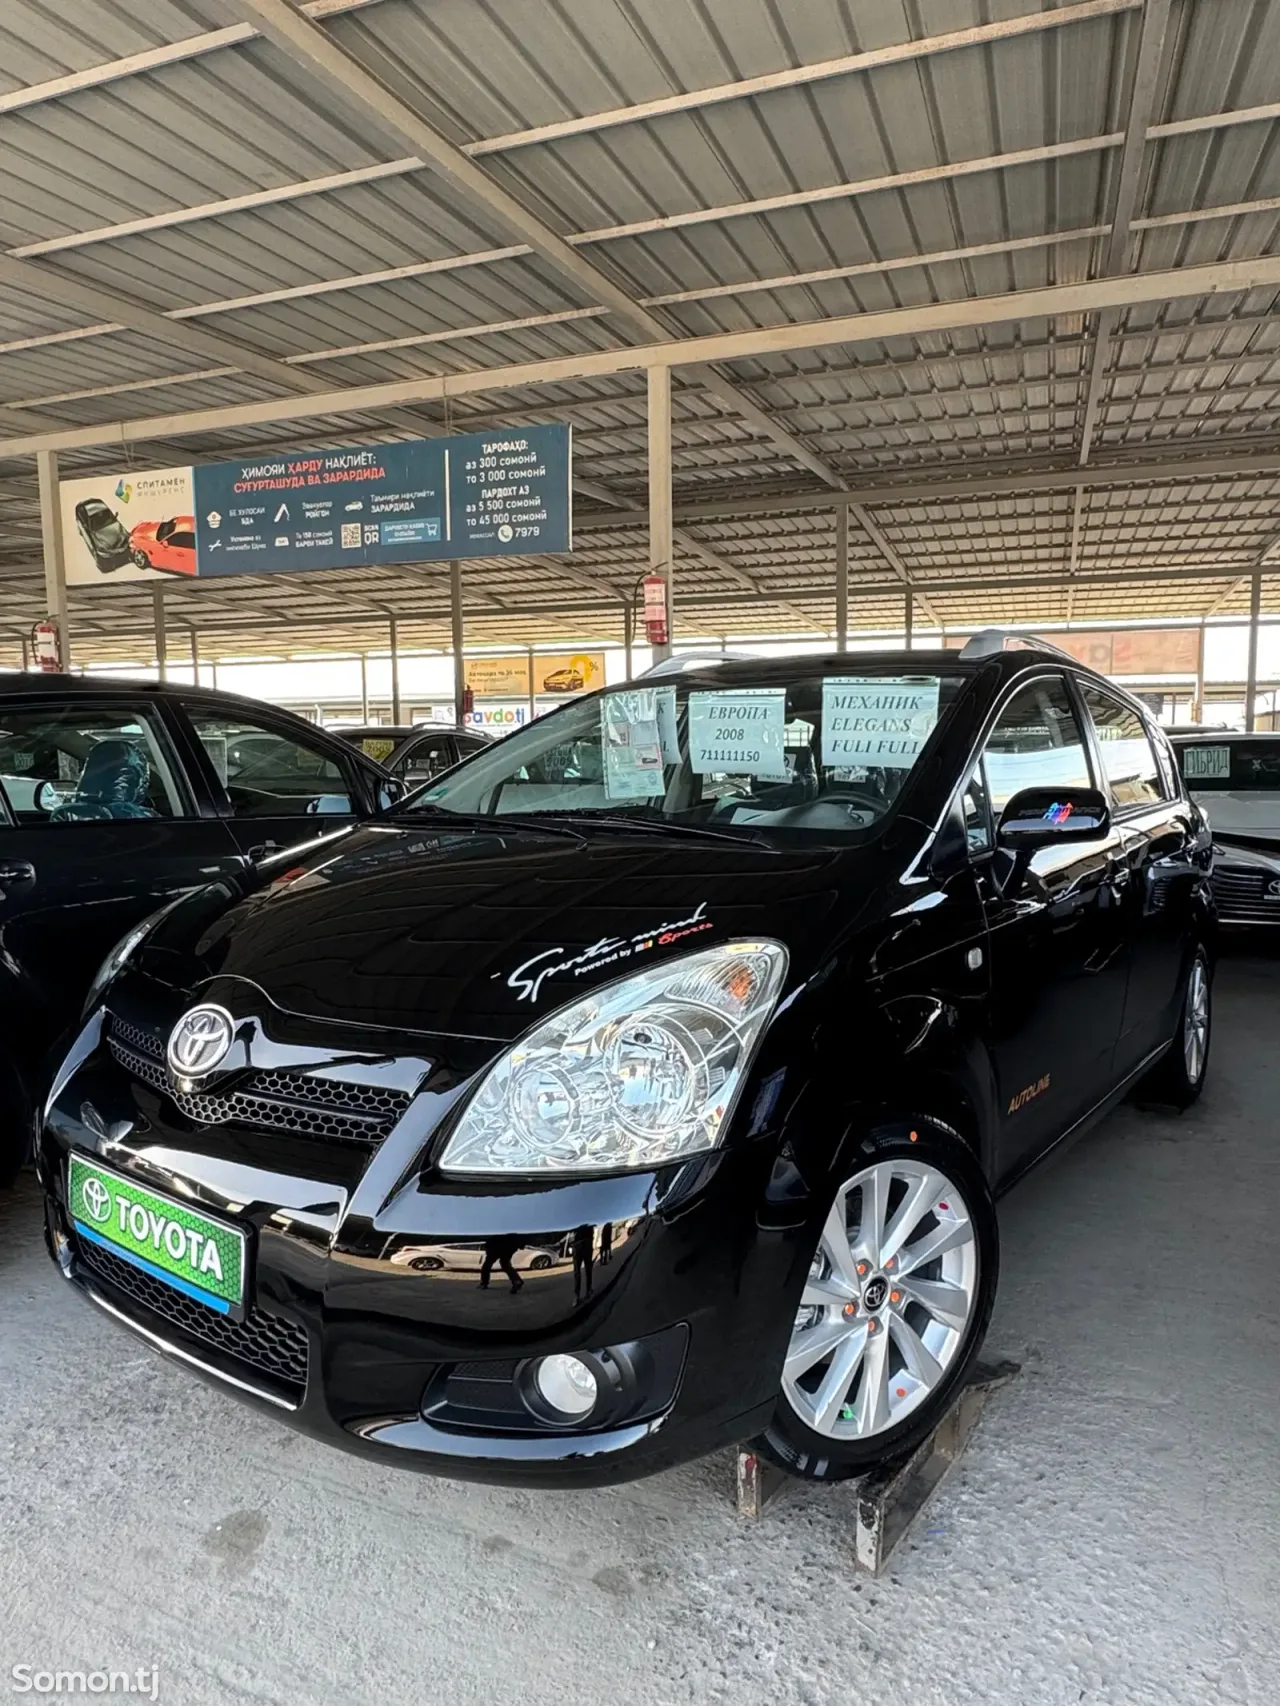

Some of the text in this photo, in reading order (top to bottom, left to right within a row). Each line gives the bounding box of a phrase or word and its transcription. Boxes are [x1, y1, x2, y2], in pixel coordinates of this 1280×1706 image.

[465, 461, 476, 470] аз
[479, 457, 497, 468] 300
[307, 475, 321, 486] ВА
[323, 467, 386, 484] ЗАРАРДИДА
[466, 475, 477, 484] то
[479, 472, 486, 482] 3
[488, 470, 506, 481] 000
[481, 487, 517, 499] ПАРДОХТ
[371, 502, 415, 513] ЗАРАРДИДА
[466, 504, 477, 513] аз
[478, 501, 485, 511] 5
[487, 499, 504, 510] 500
[466, 518, 477, 527] то
[479, 515, 490, 525] 45
[492, 513, 510, 524] 000
[364, 532, 380, 544] QR
[515, 526, 540, 537] 7979
[831, 696, 923, 710] МЕХАНИК
[708, 706, 768, 720] ЕВРОПА
[831, 718, 912, 732] ELEGANS
[715, 728, 745, 740] 2008
[877, 740, 921, 754] FULL
[700, 749, 760, 762] 711111150
[574, 952, 619, 976] Powered
[619, 948, 632, 958] by
[1007, 1072, 1051, 1115] AUTOLINE
[115, 1194, 224, 1282] TOYOTA
